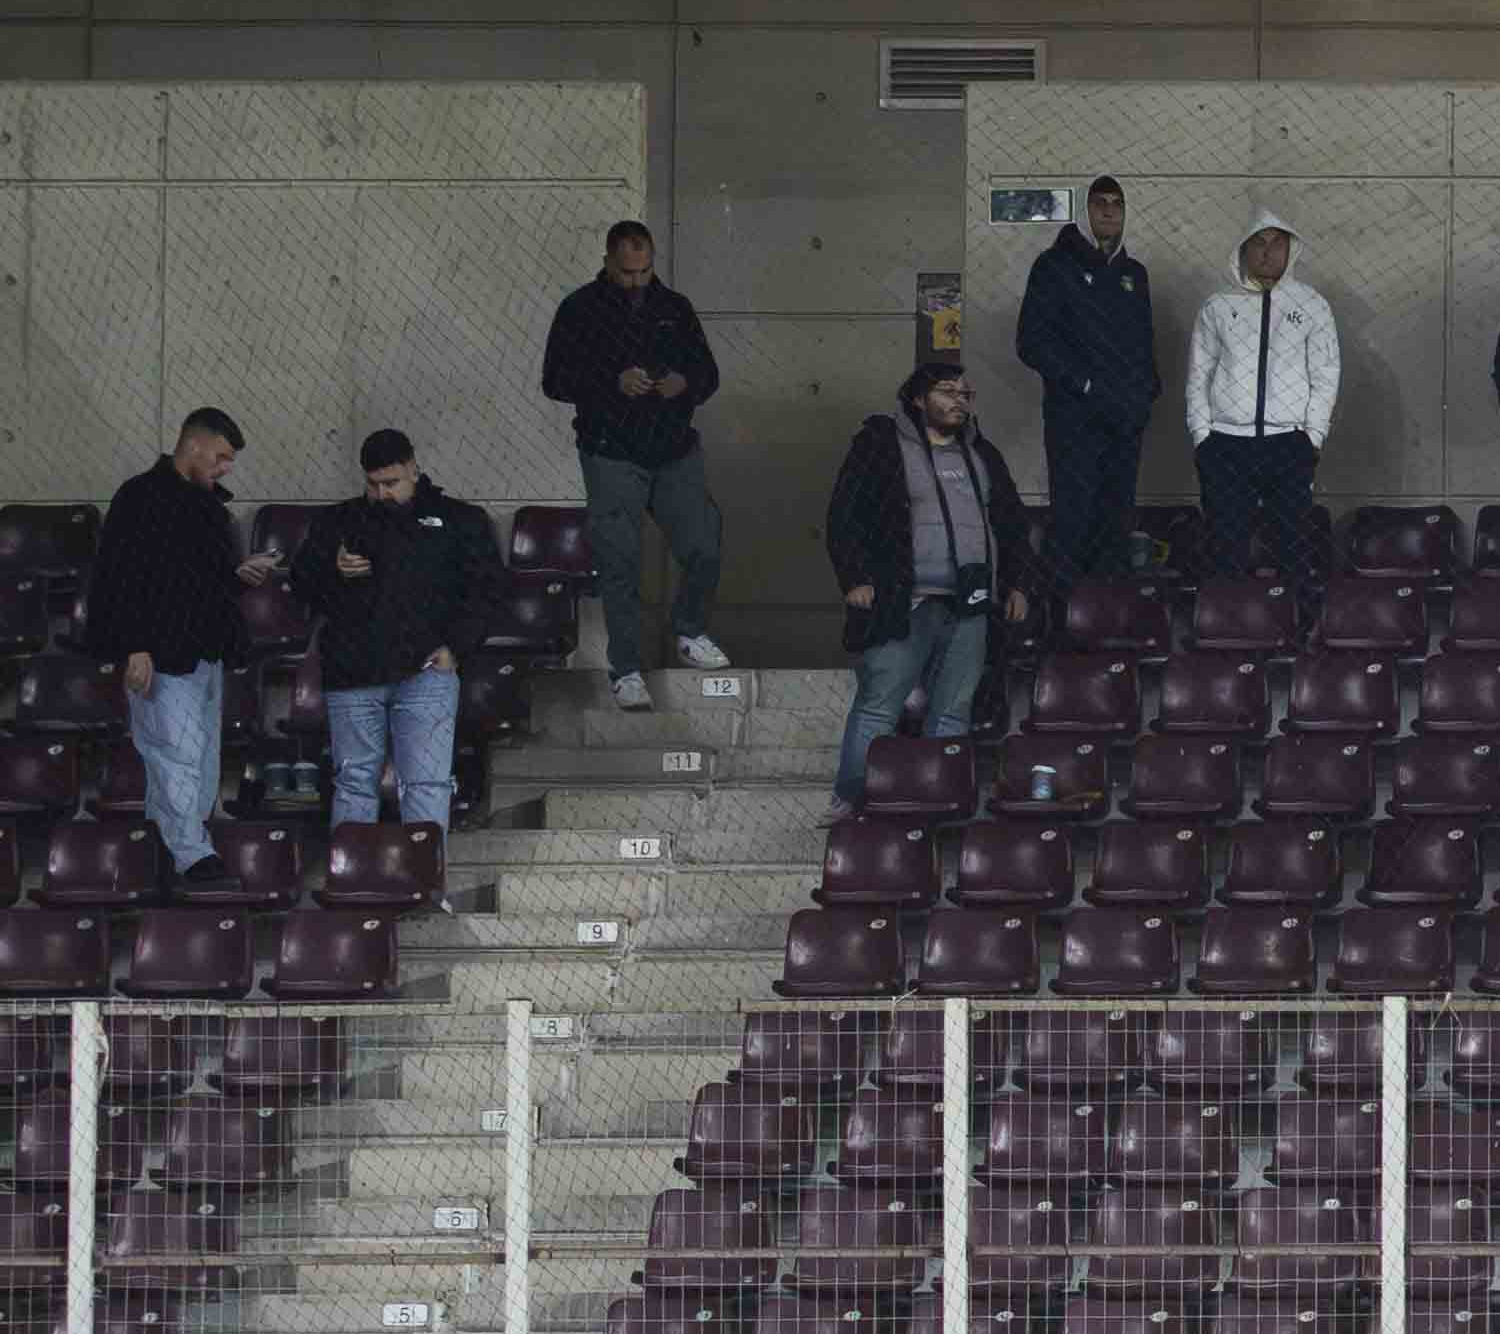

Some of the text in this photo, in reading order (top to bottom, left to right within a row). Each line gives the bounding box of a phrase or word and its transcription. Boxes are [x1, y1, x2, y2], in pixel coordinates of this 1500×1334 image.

[711, 678, 734, 695] 12
[674, 754, 694, 769] 11
[630, 840, 651, 856] 10
[592, 924, 603, 940] 9
[546, 1020, 558, 1036] 8
[450, 1210, 462, 1227] 6
[400, 1307, 411, 1324] 5
